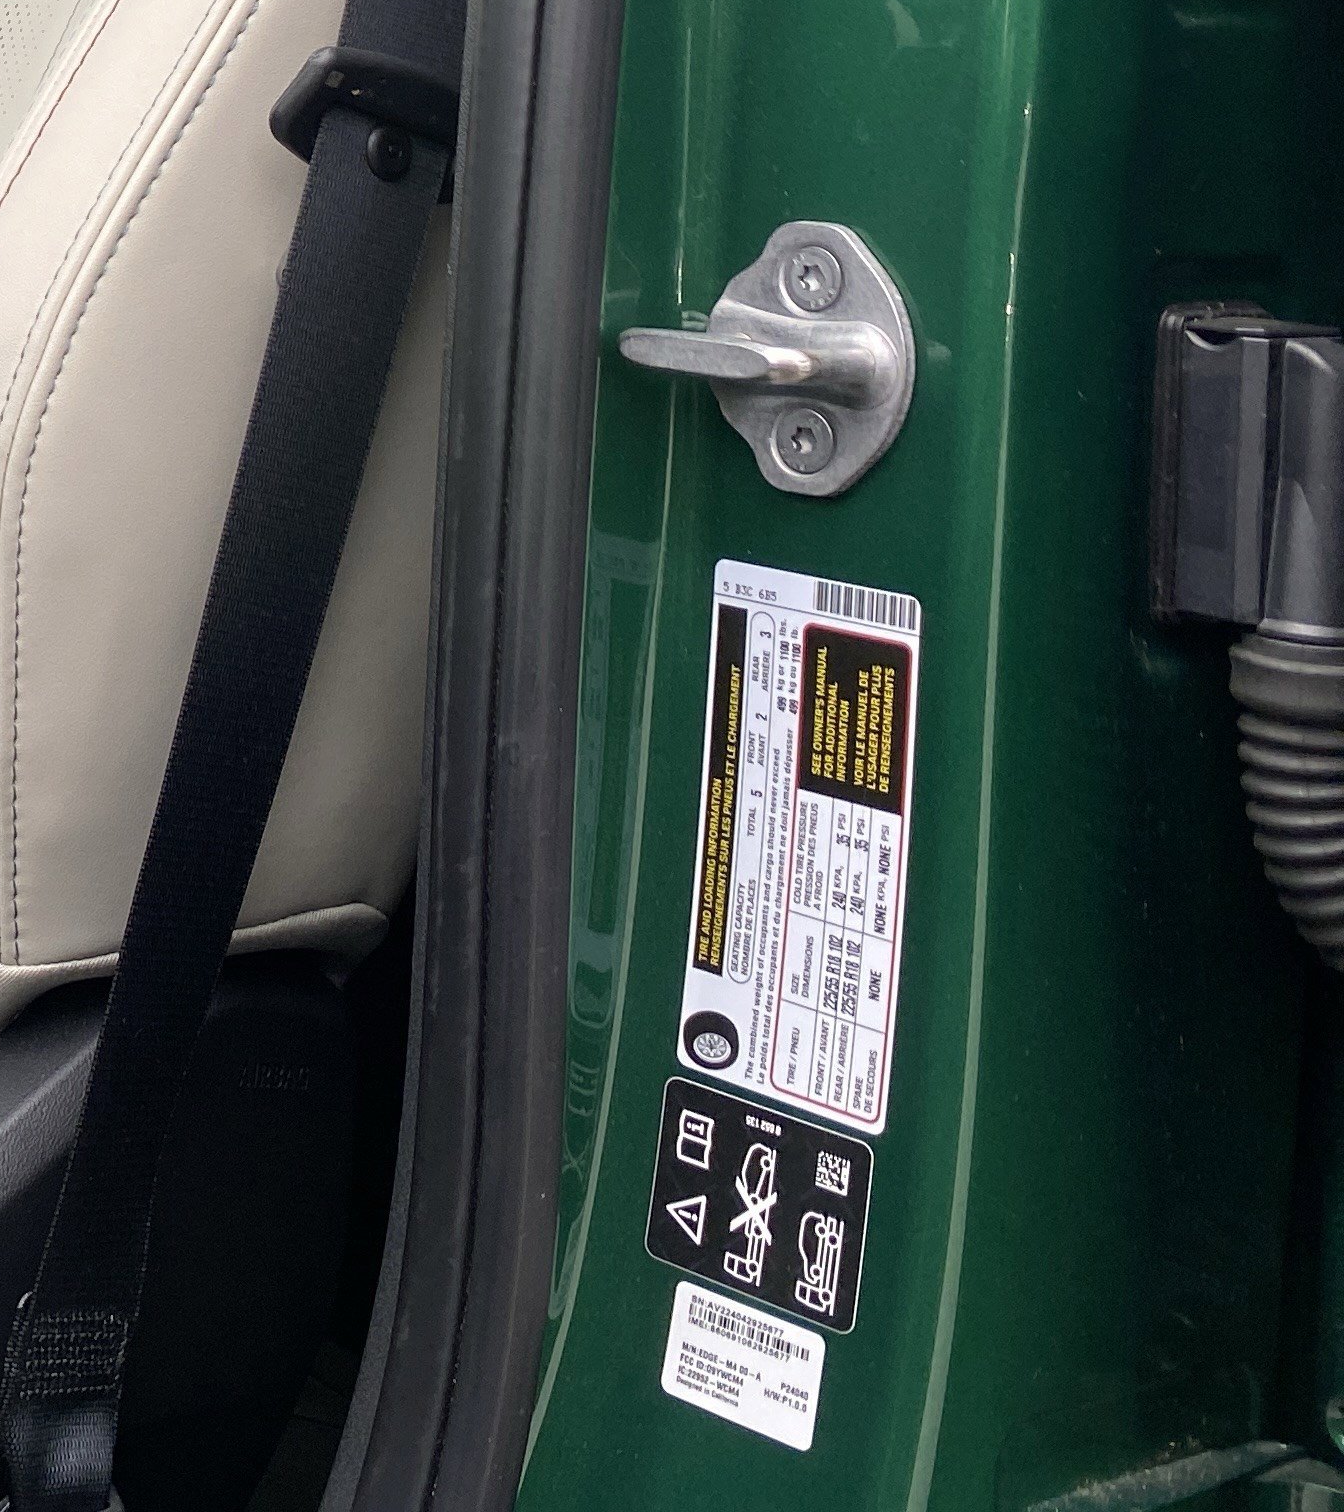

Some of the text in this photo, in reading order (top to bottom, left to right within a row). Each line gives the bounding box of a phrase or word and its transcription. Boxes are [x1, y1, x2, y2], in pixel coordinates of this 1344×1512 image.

[723, 581, 730, 592] 5
[758, 630, 772, 639] 3
[776, 618, 790, 712] 499 kg or 1100 lbs.
[791, 642, 801, 662] 1100
[751, 655, 759, 682] REAR
[789, 665, 797, 679] ou
[787, 680, 797, 694] kg
[755, 712, 767, 721] 2
[788, 698, 798, 715] 499
[810, 646, 827, 775] SEE OWNER'S MANUAL
[823, 682, 838, 778] FOR ADDITIONAL
[836, 699, 849, 781] INFORMATION
[853, 670, 869, 785] VOIR LE MANUEL DE
[866, 665, 882, 789] L'USAGER POUR PLUS
[878, 667, 894, 793] DE RENSEIGNEMENTS
[746, 729, 755, 764] FRONT
[756, 733, 765, 767] AVANT
[709, 664, 740, 966] RENSEIGNEMENTS SUR LES PNEUS ET LE CHARGEMENT
[746, 788, 762, 836] TOTAL 5
[836, 812, 846, 830] PSI
[855, 817, 865, 835] PSI
[835, 832, 850, 847] 35
[853, 837, 869, 852] 35
[880, 824, 890, 842] PSI
[697, 777, 721, 960] TIRE AND LOADING INFORMATION
[792, 801, 808, 904] COLD TIRE PRESSURE
[803, 802, 818, 907] PRESSION DES PNEUS
[878, 843, 891, 875] NONE
[813, 870, 823, 901] FROID
[830, 890, 847, 911] 240
[744, 747, 780, 1079] The combined weight of occupants and cargo should never exceed
[756, 728, 793, 1085] Le poids total des occupants et du chargement ne doit jamais dépasser
[848, 895, 865, 916] 240
[873, 902, 887, 934] NONE
[730, 882, 745, 972] SEATING CAPACITY
[740, 878, 756, 975] NOMBRE DE PLACES
[800, 935, 814, 998] DIMENSIONS
[822, 933, 843, 1011] 225/55 R18 102
[840, 939, 861, 1017] 225/55 R18 102
[790, 972, 800, 995] SIZE
[867, 969, 881, 1001] NONE
[789, 1026, 800, 1055] PNEU
[818, 1018, 829, 1054] AVANT
[785, 1062, 796, 1084] TIRE
[813, 1060, 825, 1096] FRONT
[833, 1074, 843, 1102] REAR
[863, 1049, 878, 1113] DE SECOURS
[852, 1076, 863, 1109] SPARE
[679, 1352, 694, 1366] FCC
[675, 1375, 738, 1407] Designed in California
